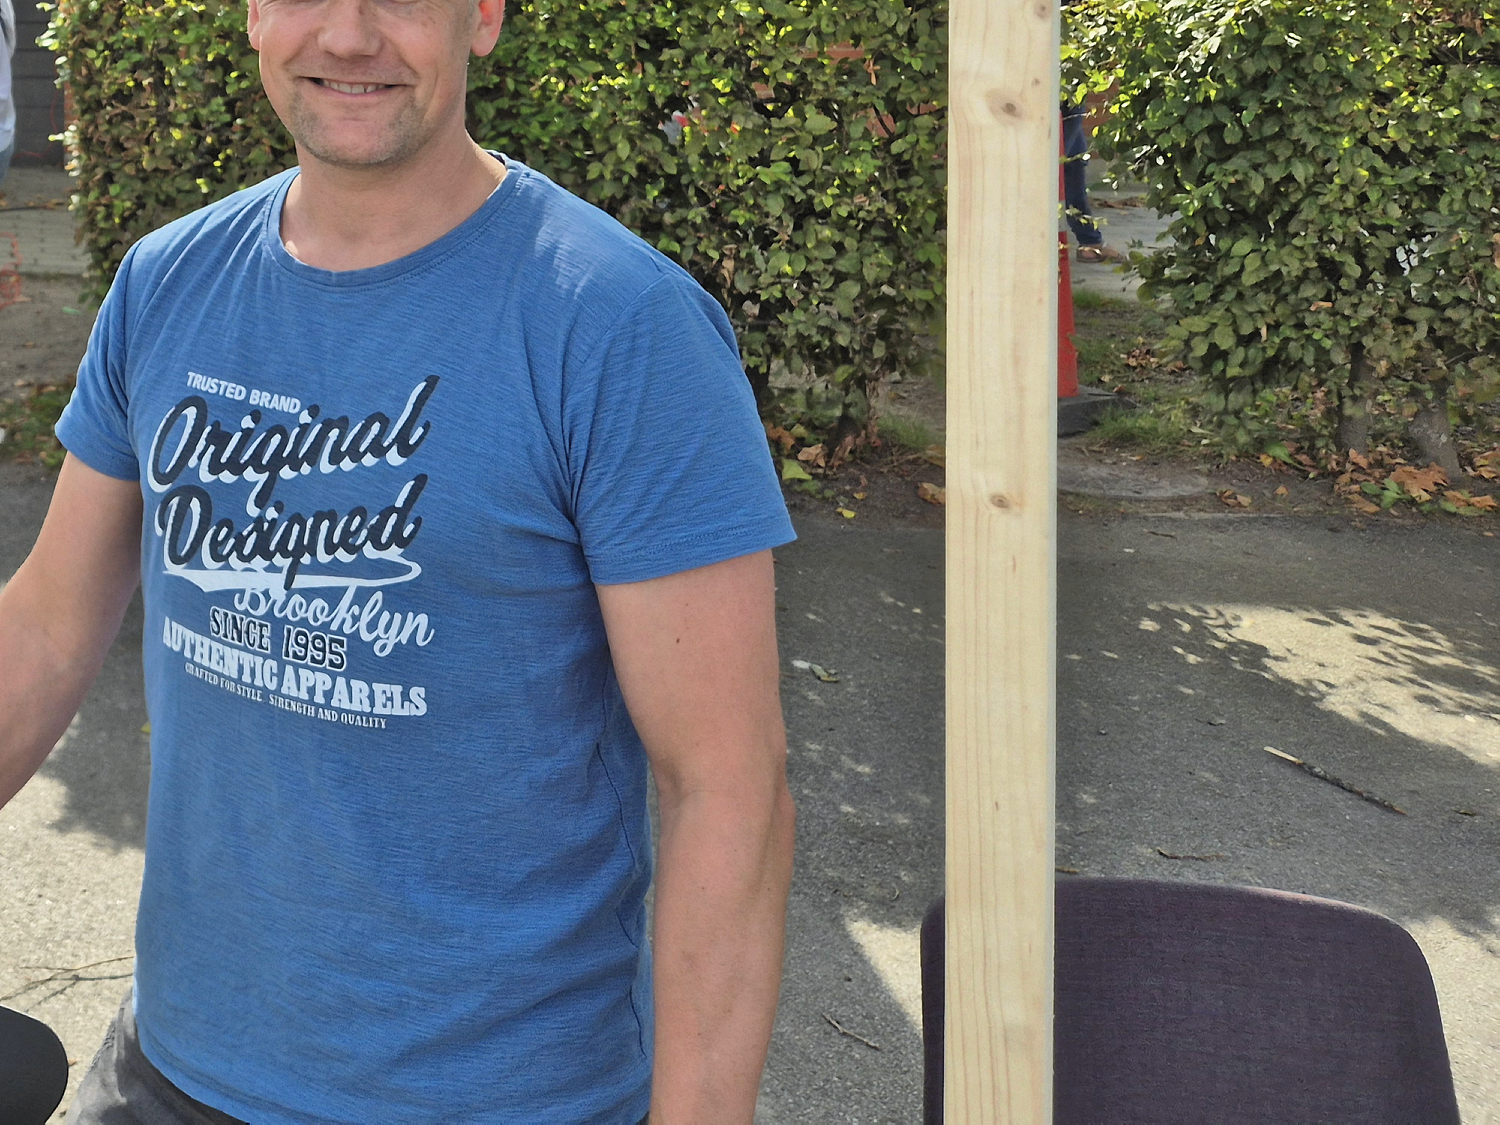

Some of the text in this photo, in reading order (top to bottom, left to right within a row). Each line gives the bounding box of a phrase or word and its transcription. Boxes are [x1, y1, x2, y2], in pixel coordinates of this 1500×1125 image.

[187, 372, 301, 414] TRUSTED BRAND
[147, 374, 441, 518] Original
[155, 473, 429, 591] Designed
[209, 606, 348, 672] SINCE 1995
[234, 584, 435, 657] Brooklyn
[162, 616, 428, 717] AUTHENTIC APPARELS
[184, 661, 219, 685] CRAFTED
[219, 677, 237, 695] FOR
[268, 693, 315, 718] STRENGTH
[317, 707, 338, 723] AND
[340, 712, 388, 730] QUALITY
